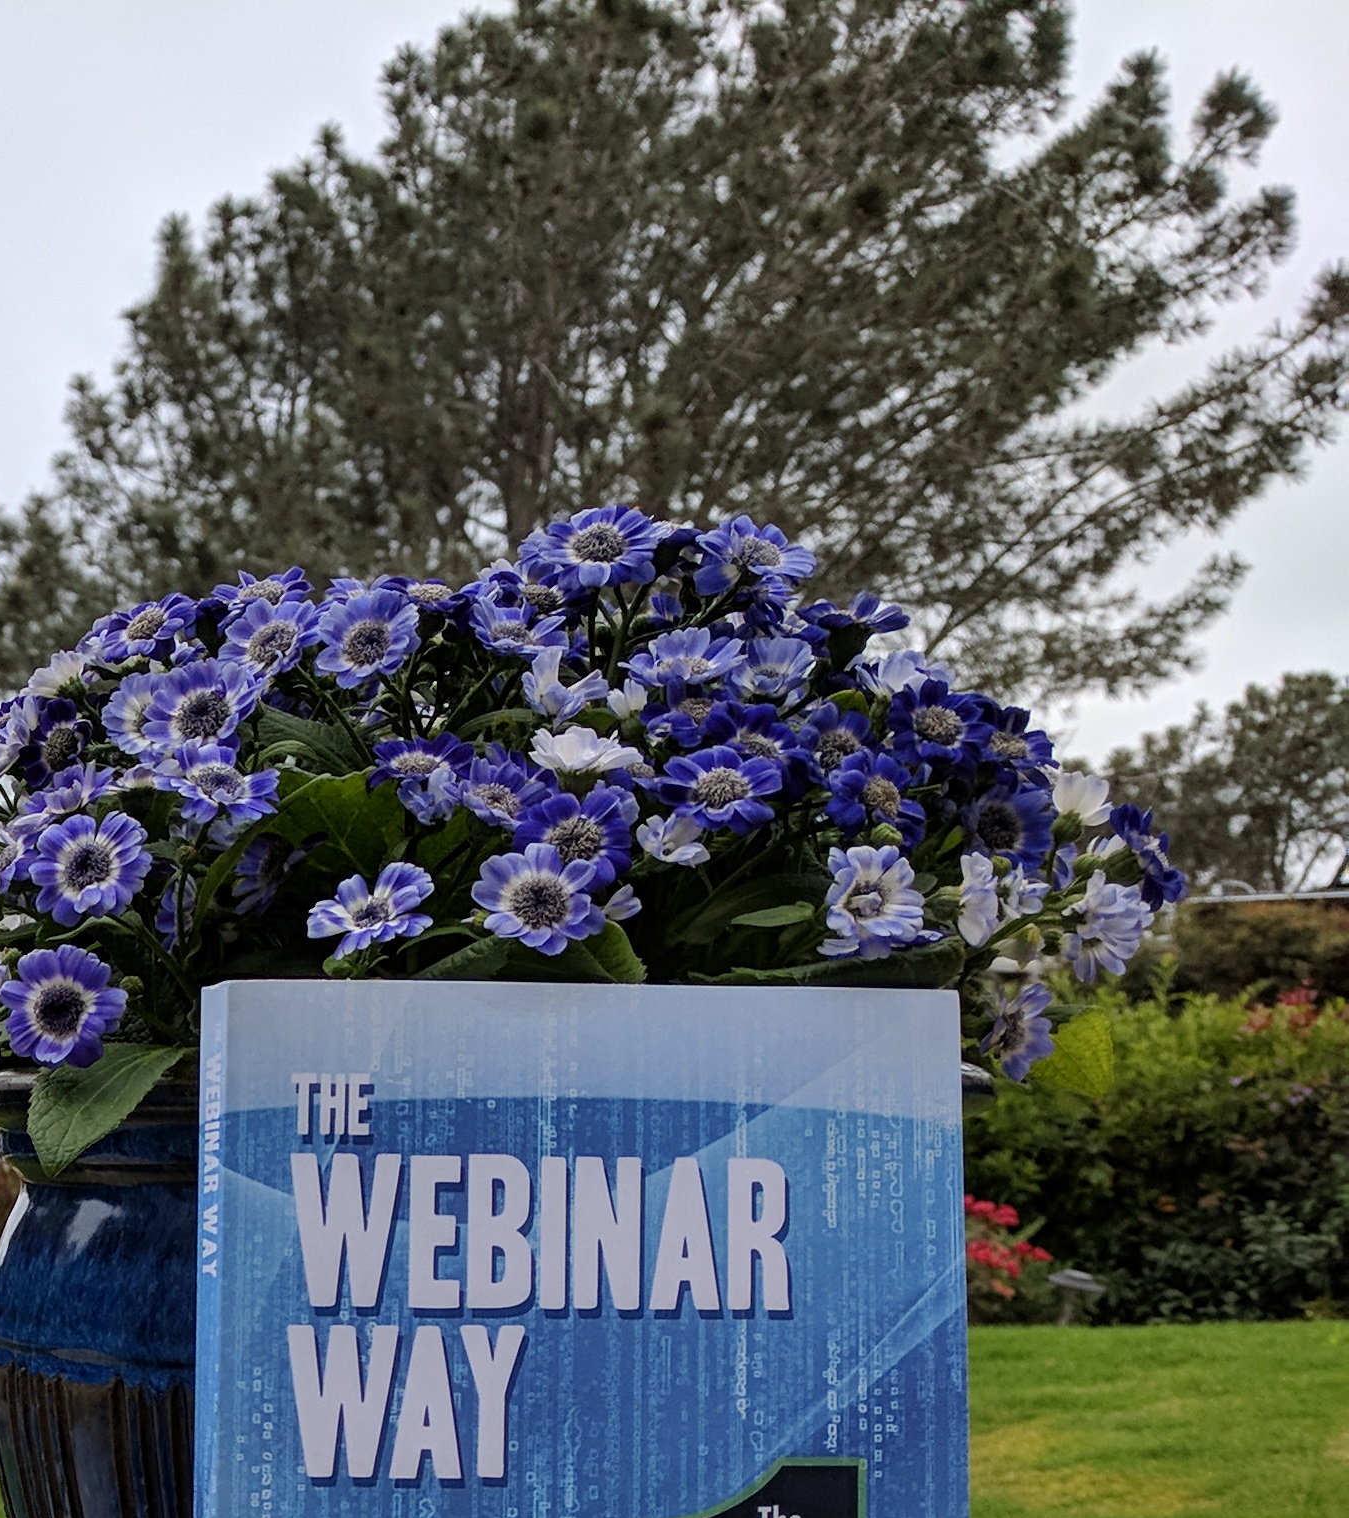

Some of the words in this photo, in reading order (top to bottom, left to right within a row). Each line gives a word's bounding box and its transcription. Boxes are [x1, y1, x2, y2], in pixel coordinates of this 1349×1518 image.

[203, 1052, 222, 1195] WEBINAR
[292, 1073, 372, 1135] THE
[201, 1203, 220, 1278] WAY
[290, 1153, 791, 1312] WEBINAR
[286, 1324, 525, 1480] WAY
